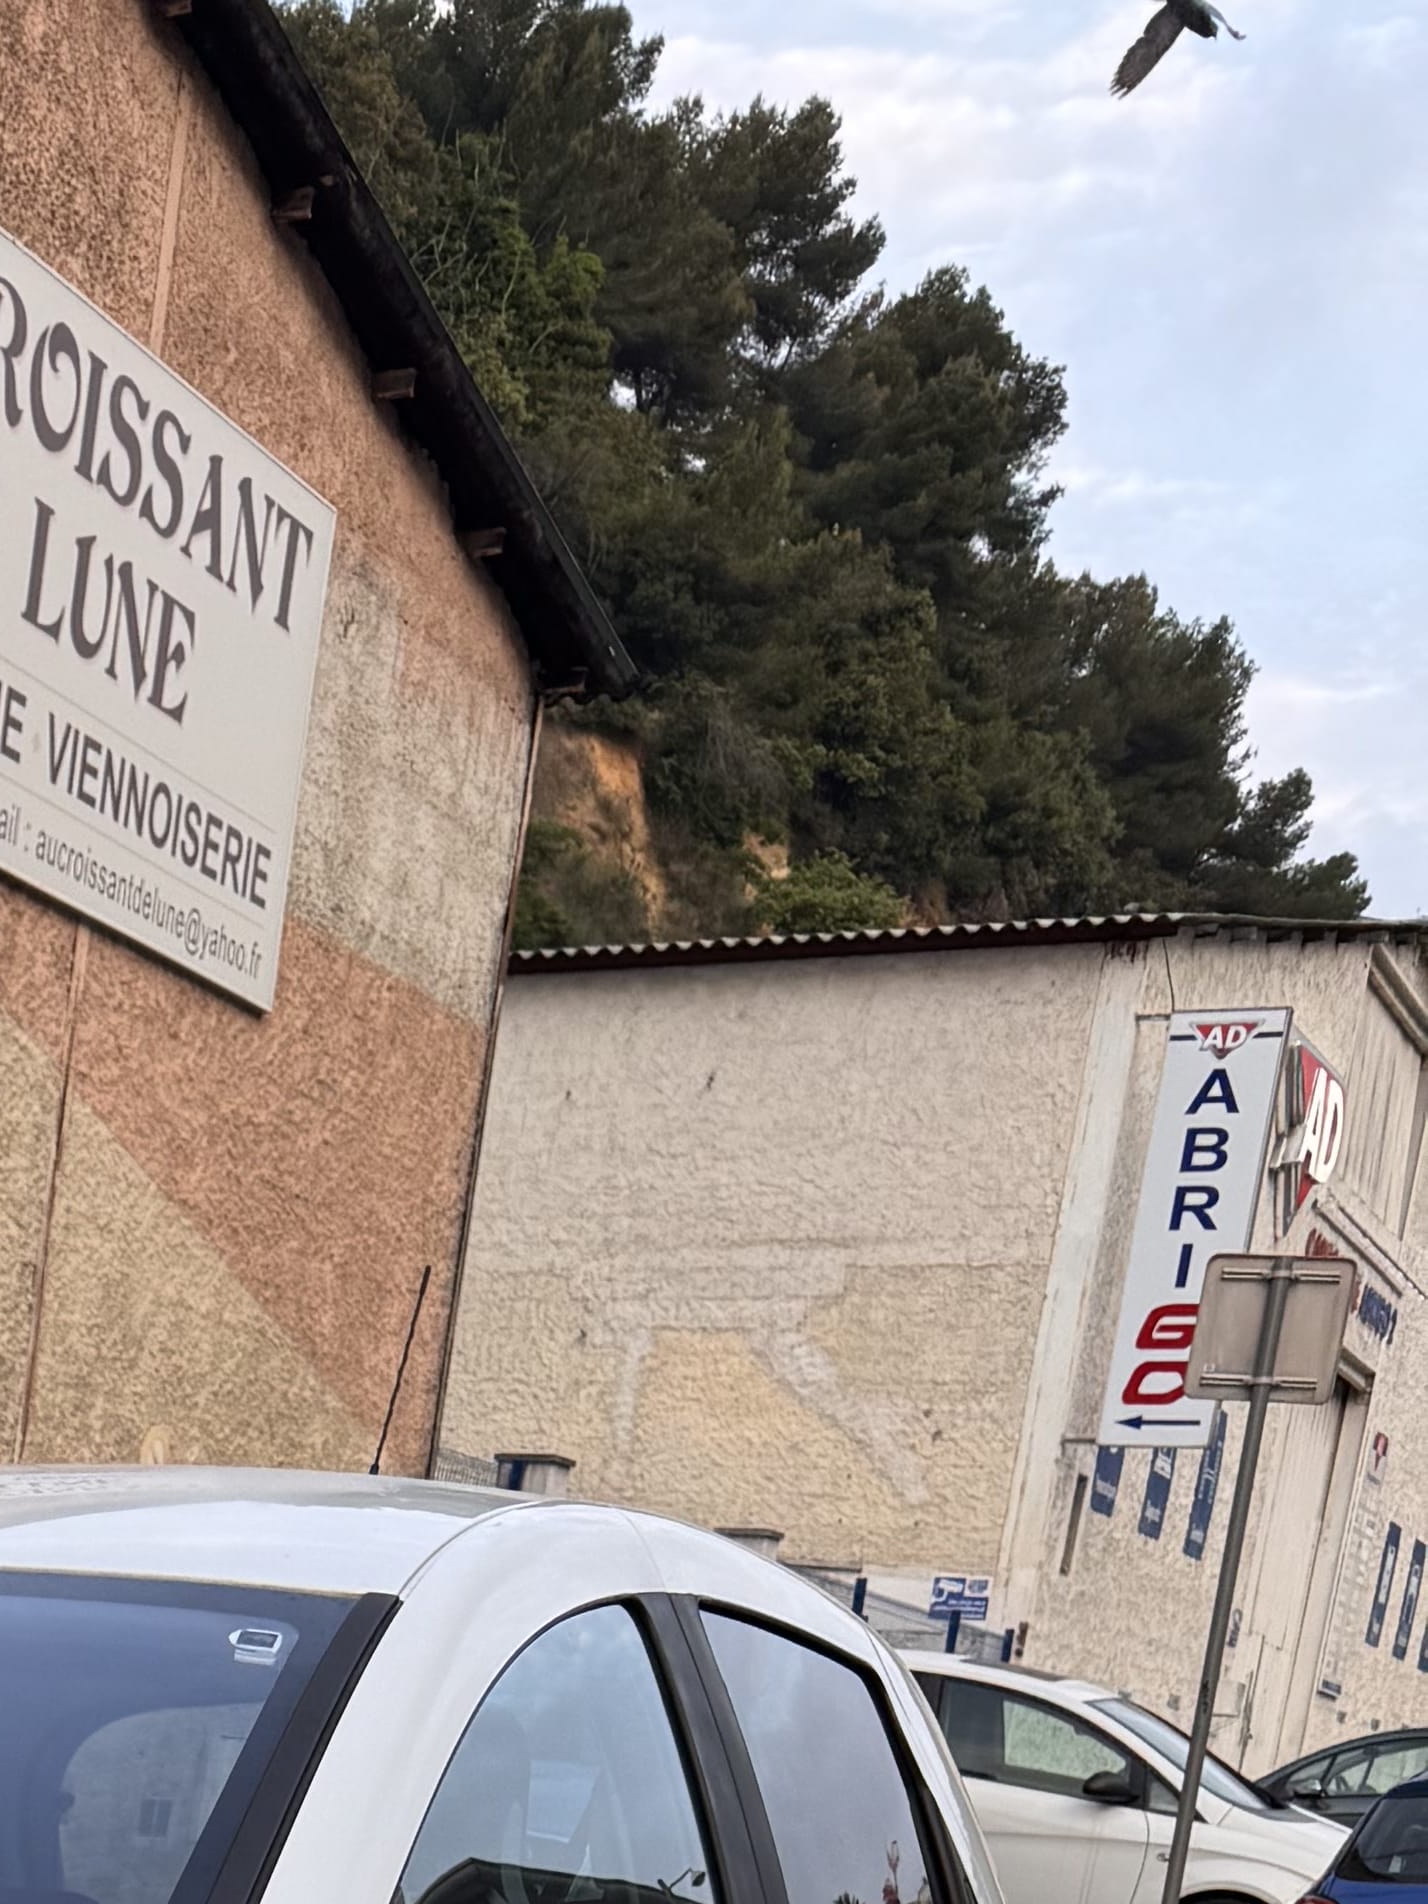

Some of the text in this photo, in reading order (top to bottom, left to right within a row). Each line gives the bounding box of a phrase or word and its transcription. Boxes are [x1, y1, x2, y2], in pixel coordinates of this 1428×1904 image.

[20, 497, 198, 724] LUNE
[47, 711, 272, 910] VIENNOISERIE
[35, 828, 263, 980] aucroissantdelune@yahoo.fr
[1203, 1024, 1248, 1050] AD
[1300, 1066, 1344, 1184] AD
